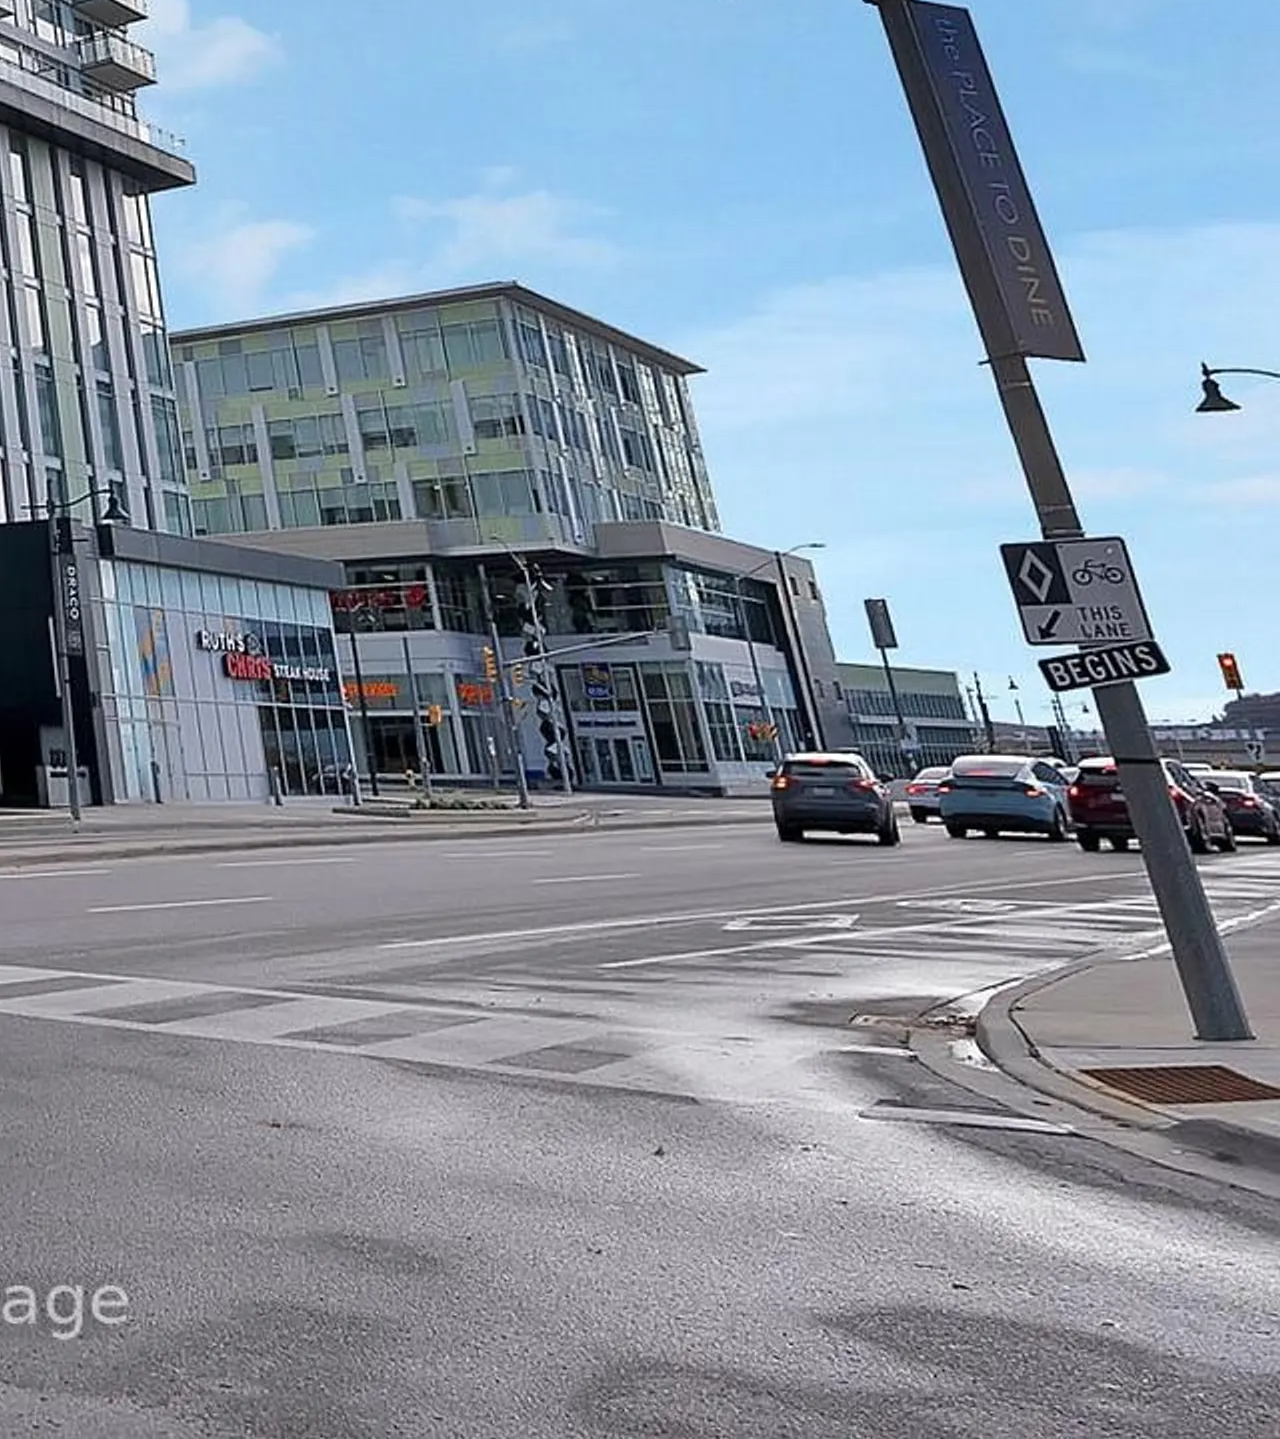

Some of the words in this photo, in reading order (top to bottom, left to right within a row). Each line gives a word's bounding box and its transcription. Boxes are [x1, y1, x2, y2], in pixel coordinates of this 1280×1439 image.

[934, 16, 960, 61] the
[954, 70, 1002, 169] PLACE
[989, 180, 1019, 226] TO
[1006, 236, 1057, 327] DINE
[66, 565, 80, 621] DRACO
[1076, 604, 1124, 622] THIS
[1078, 622, 1133, 639] LANE
[225, 652, 272, 679] CHRIS
[302, 667, 331, 682] HOUSE
[1047, 645, 1158, 688] BEGINS
